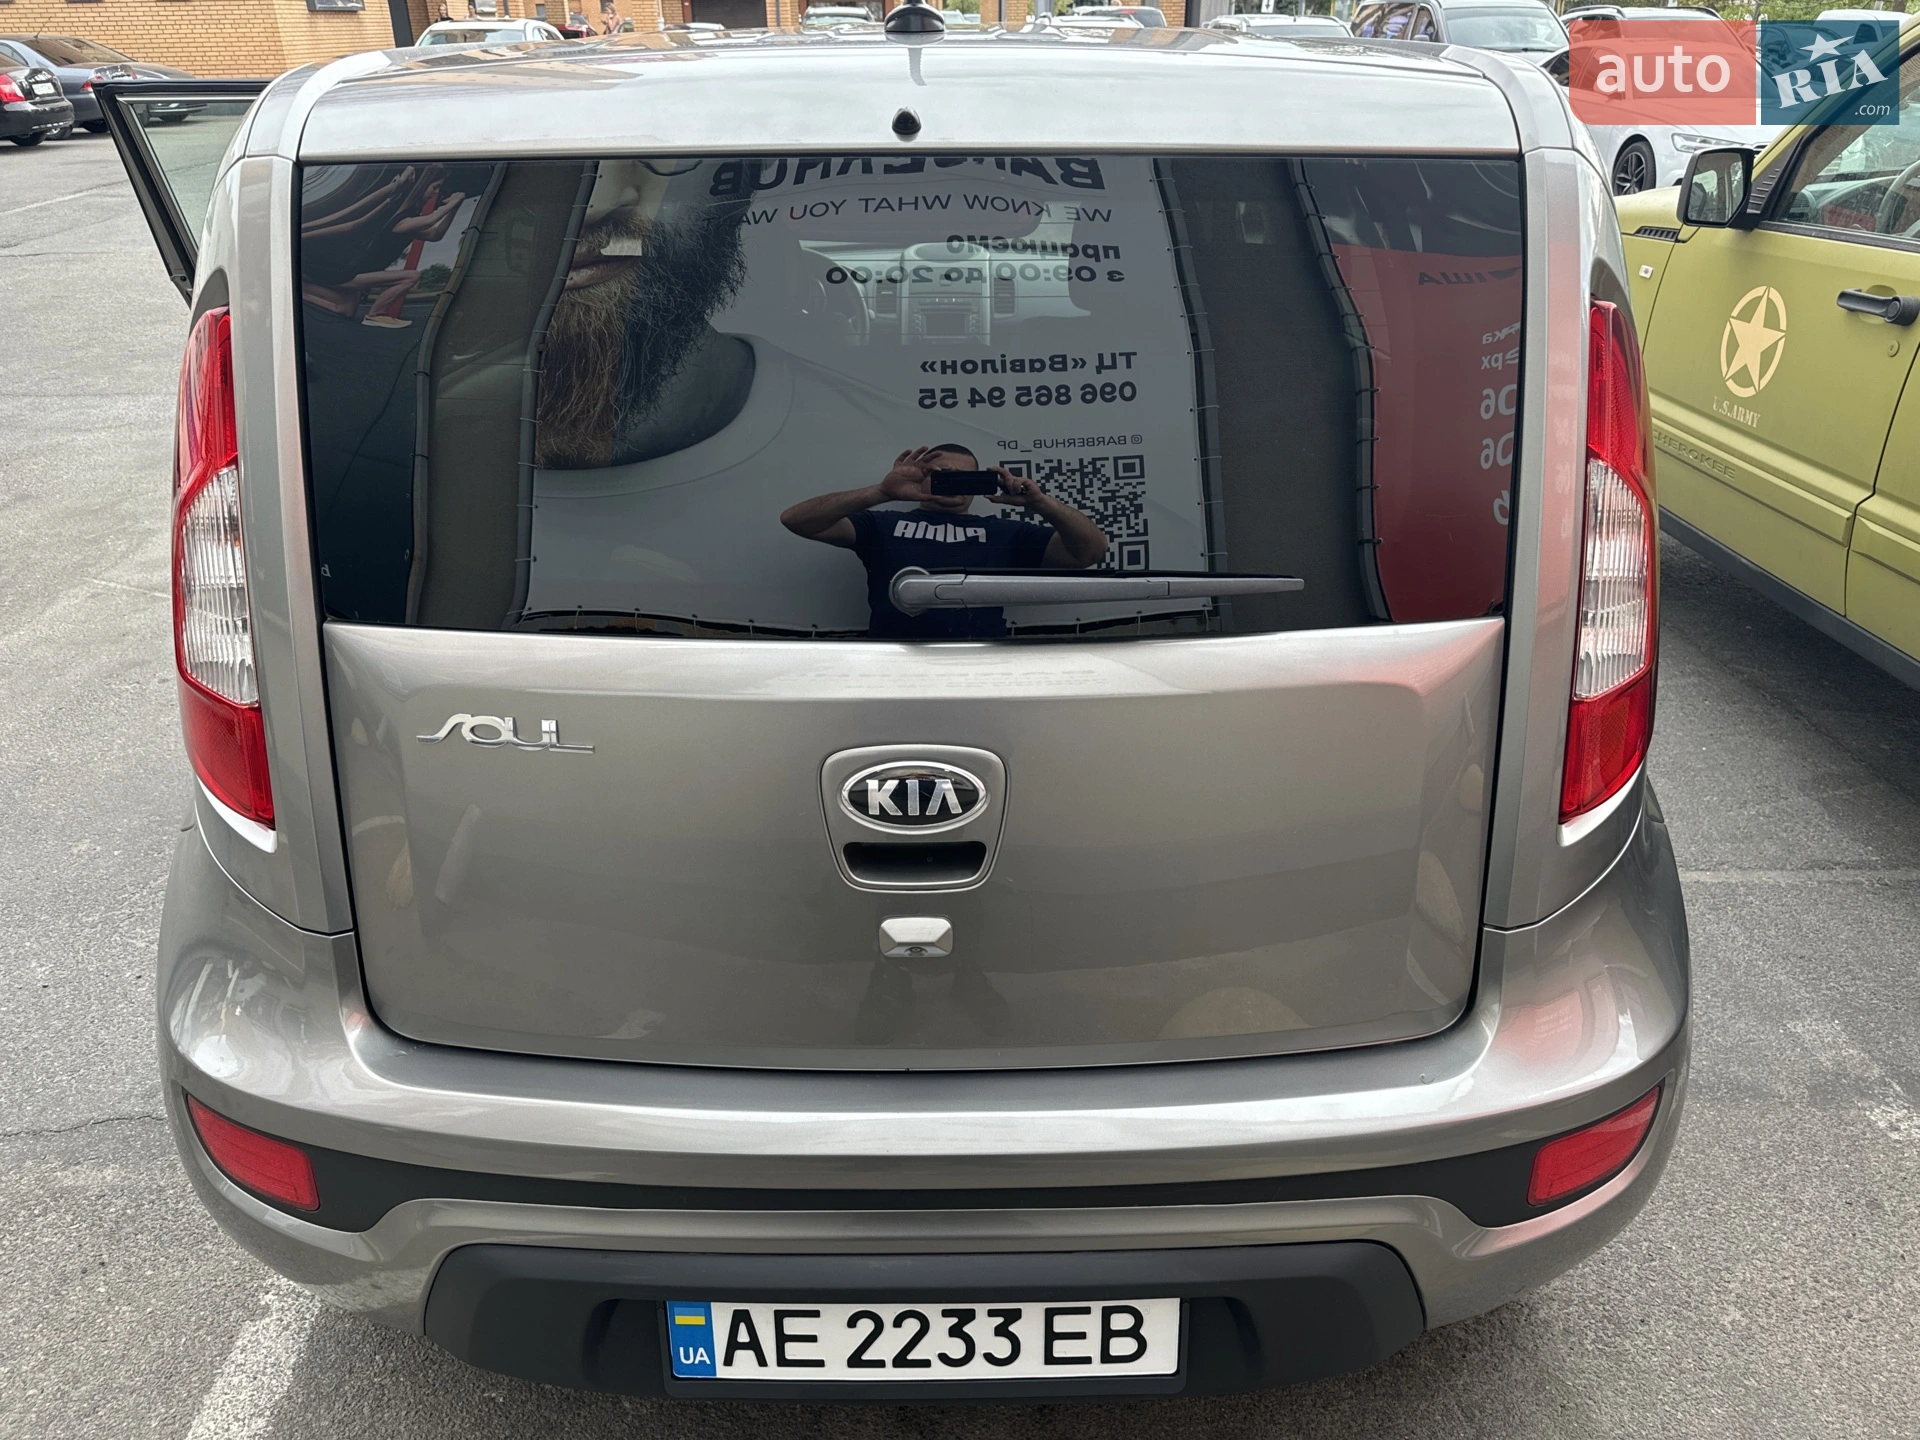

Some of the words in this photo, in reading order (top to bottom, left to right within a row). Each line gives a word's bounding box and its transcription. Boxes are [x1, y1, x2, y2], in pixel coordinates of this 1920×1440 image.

[416, 713, 595, 754] SOUL
[866, 779, 963, 816] KIA
[679, 1346, 711, 1365] UA
[722, 1308, 825, 1368] AE
[846, 1308, 1022, 1369] 2233
[1043, 1304, 1148, 1366] EB
